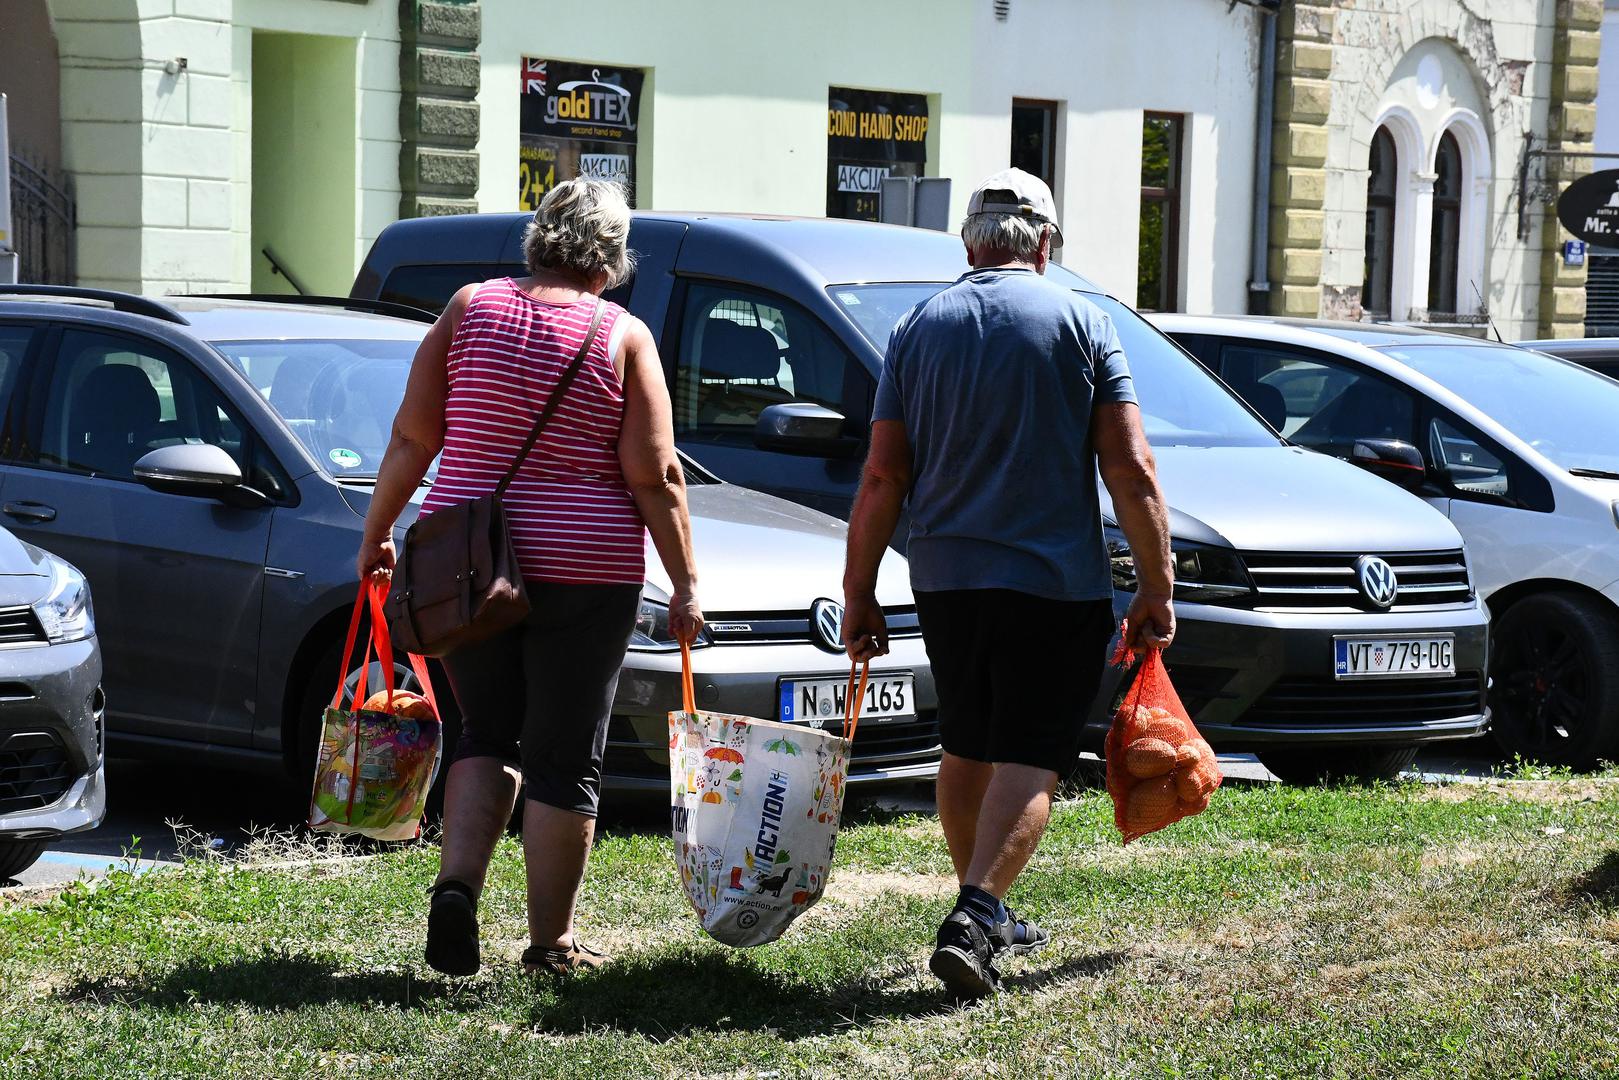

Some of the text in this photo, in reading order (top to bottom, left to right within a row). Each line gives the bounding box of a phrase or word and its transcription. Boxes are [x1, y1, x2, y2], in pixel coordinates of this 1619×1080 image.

[544, 90, 635, 131] goldTEX
[571, 126, 623, 138] second hand shop
[828, 109, 928, 142] COND HAND SHOP
[582, 157, 629, 179] AKCIJA
[839, 167, 886, 190] AKCIJA
[520, 162, 555, 211] 2+1
[856, 198, 874, 212] 2+1
[1583, 216, 1611, 234] Mr.
[1337, 661, 1347, 669] HR
[1349, 641, 1451, 672] VT 779-DG
[802, 685, 817, 716] N
[866, 680, 905, 713] 163
[784, 705, 791, 715] D
[754, 783, 787, 864] ACTION
